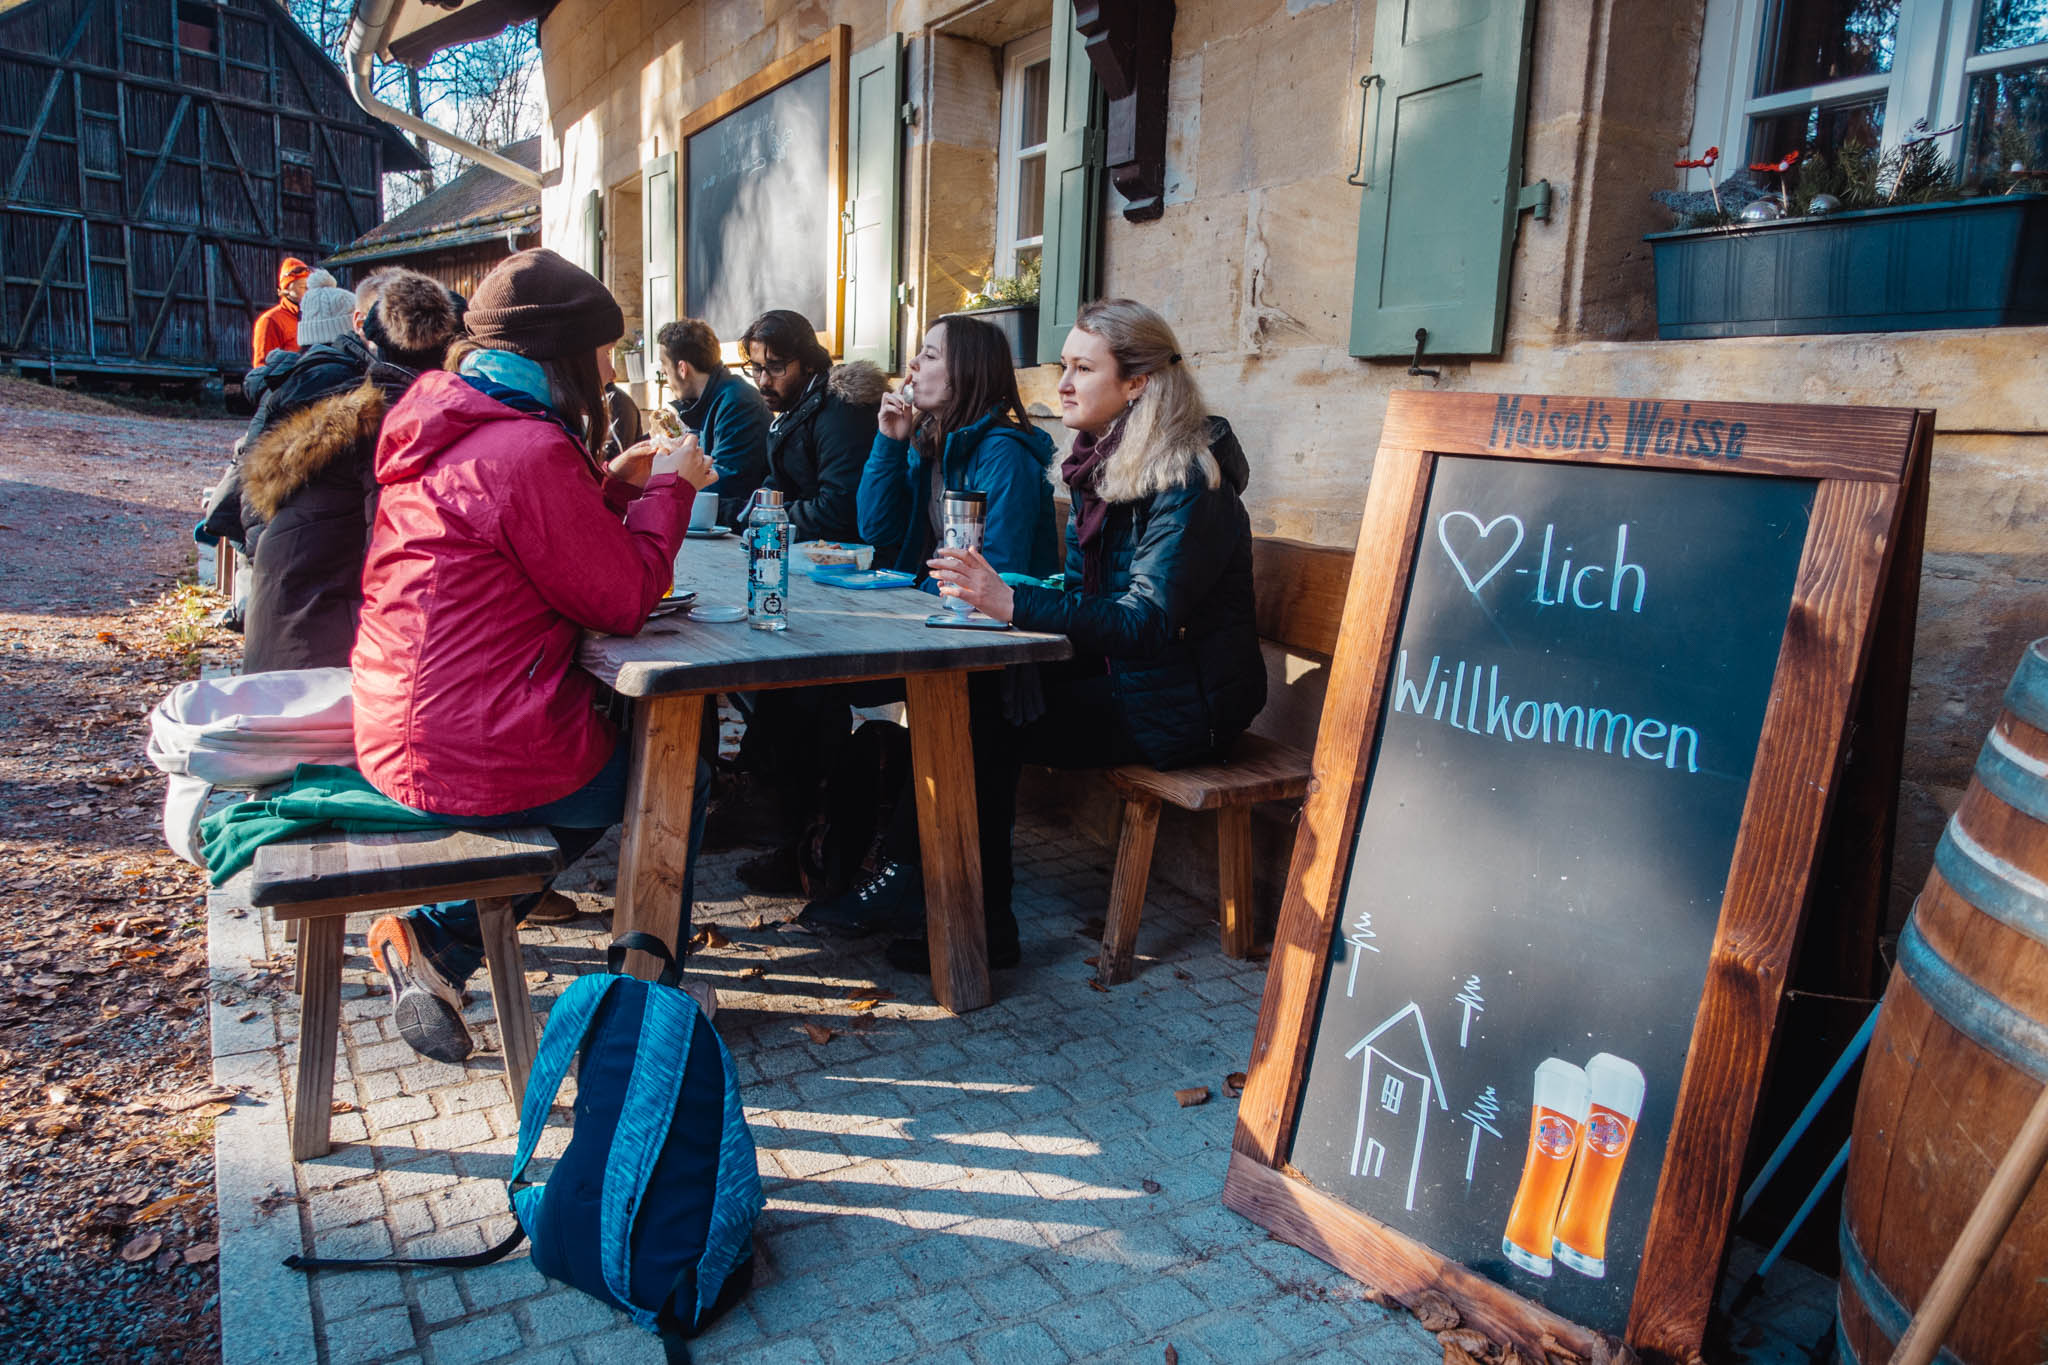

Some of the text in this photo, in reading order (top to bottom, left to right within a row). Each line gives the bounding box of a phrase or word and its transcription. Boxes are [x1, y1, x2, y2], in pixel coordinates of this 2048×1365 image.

[1489, 395, 1748, 460] Maisel's Weisse
[1394, 649, 1699, 774] Willkommen
